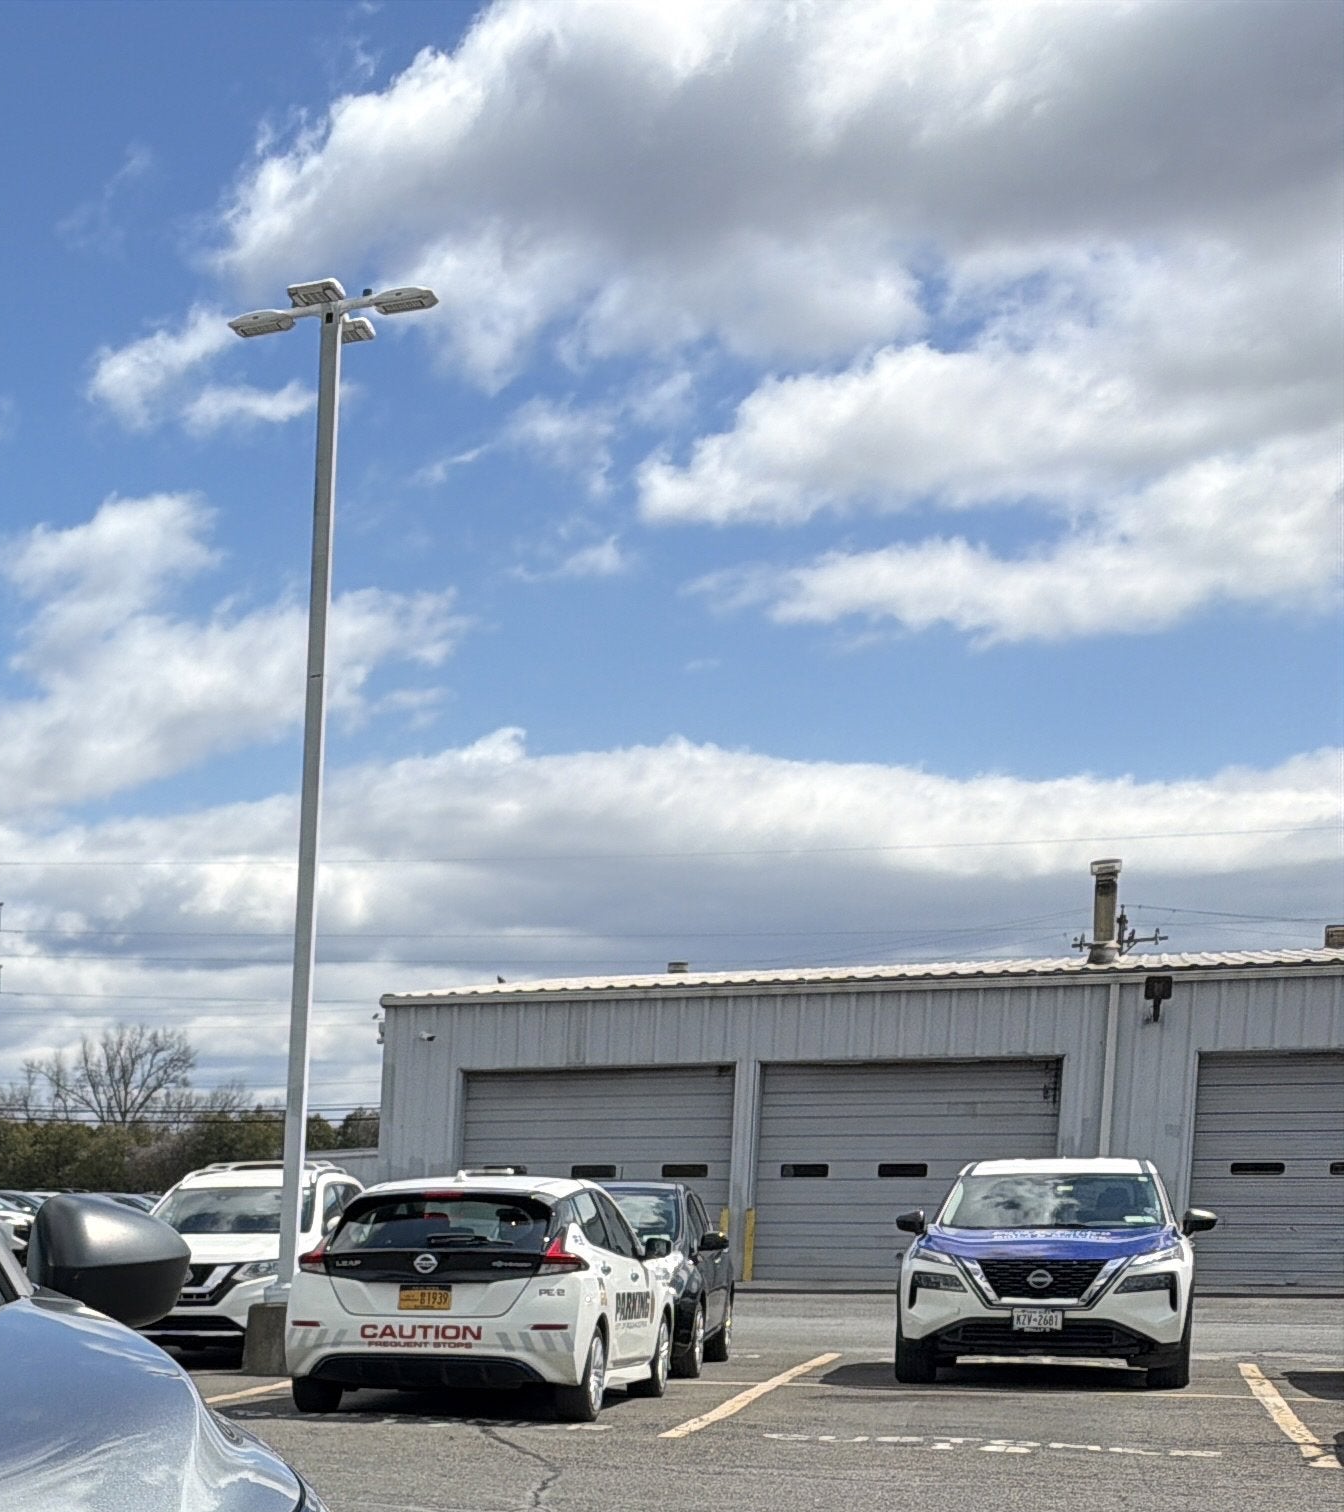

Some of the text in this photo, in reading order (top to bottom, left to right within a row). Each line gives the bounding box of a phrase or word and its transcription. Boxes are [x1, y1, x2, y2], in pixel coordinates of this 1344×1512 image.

[615, 1291, 650, 1321] PARKING
[360, 1324, 482, 1341] CAUTION
[433, 1341, 473, 1349] STOPS
